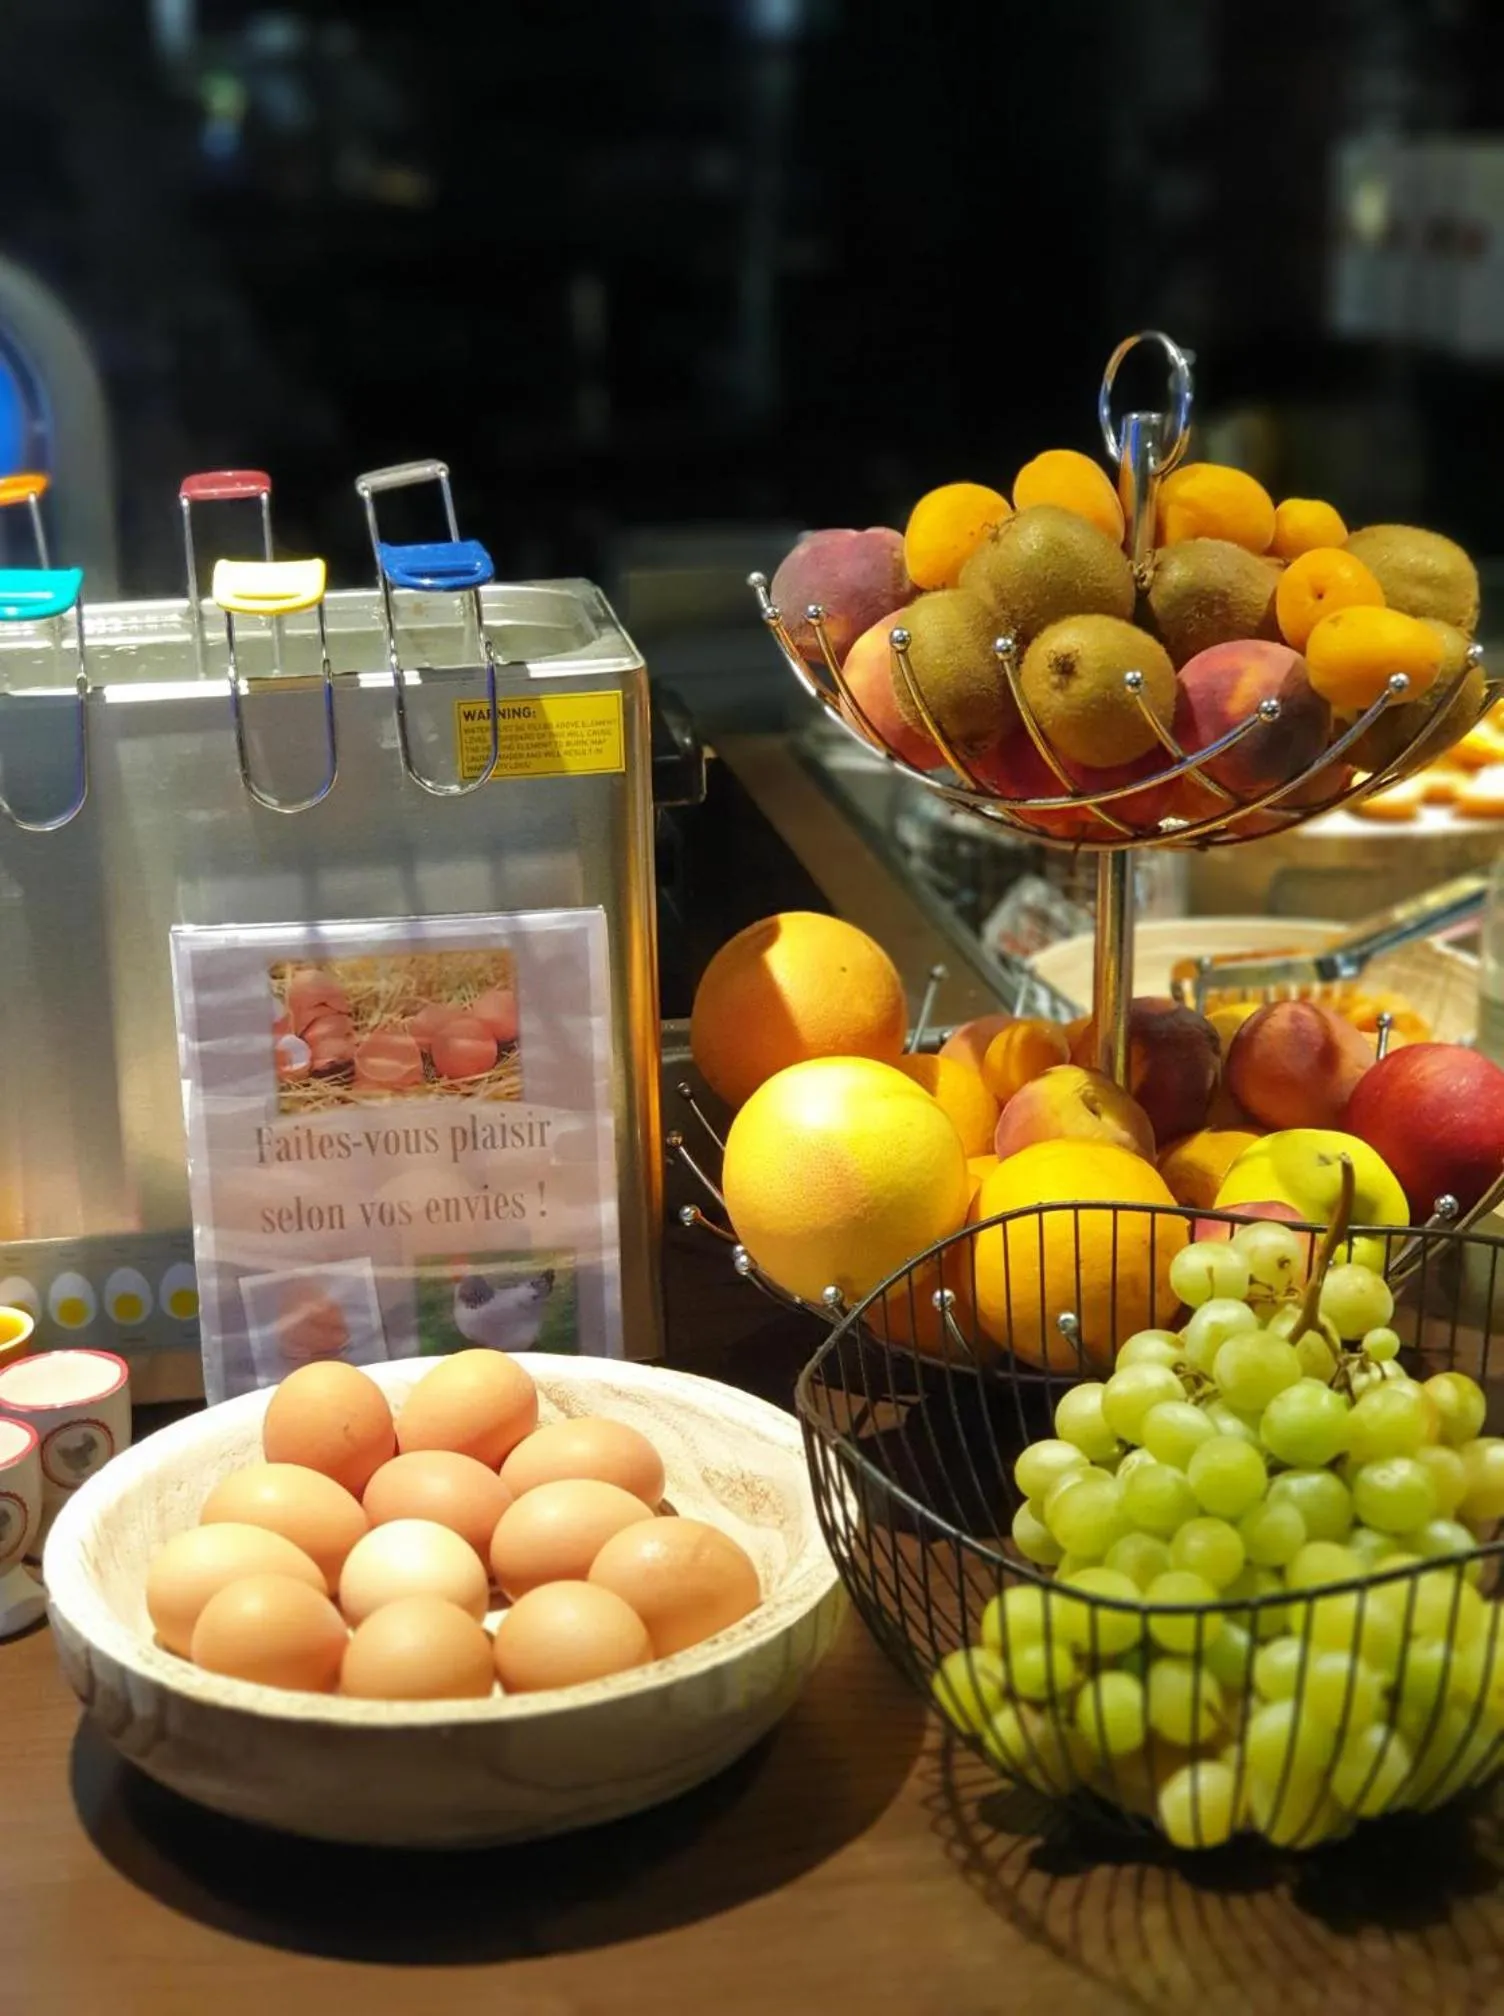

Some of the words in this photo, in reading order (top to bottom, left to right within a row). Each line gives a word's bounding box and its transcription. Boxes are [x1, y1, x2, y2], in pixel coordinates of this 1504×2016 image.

[254, 1124, 440, 1164] Faites-vous
[450, 1110, 552, 1163] plaisir
[260, 1195, 345, 1234] selon
[359, 1199, 413, 1229] vos
[425, 1183, 527, 1224] envies
[537, 1180, 548, 1218] !
